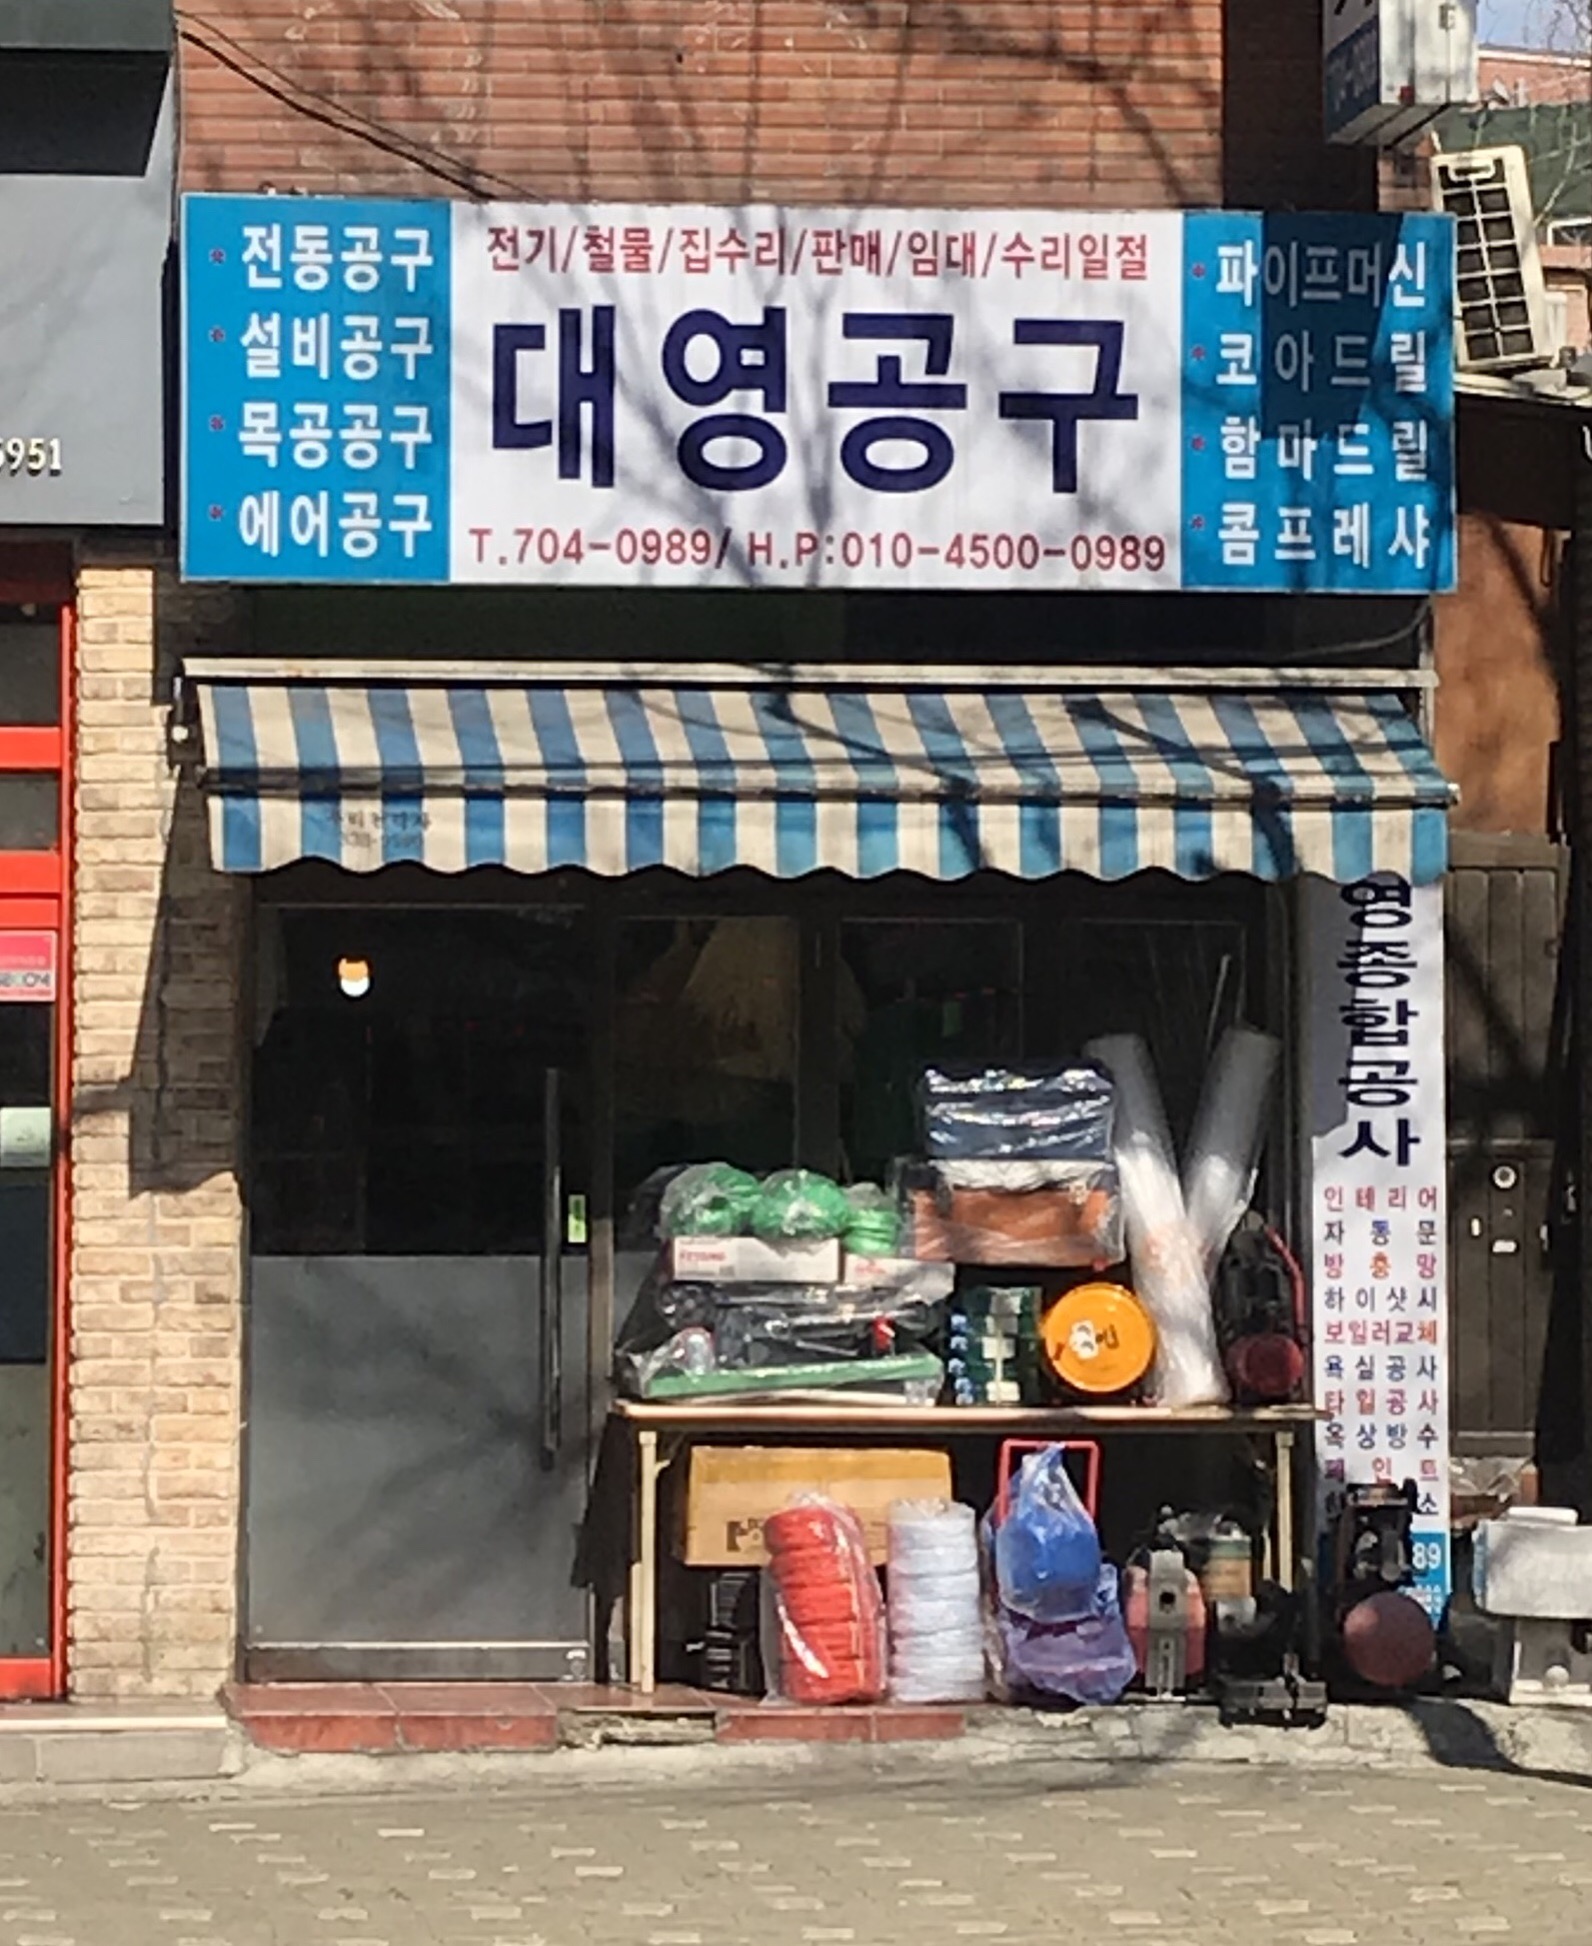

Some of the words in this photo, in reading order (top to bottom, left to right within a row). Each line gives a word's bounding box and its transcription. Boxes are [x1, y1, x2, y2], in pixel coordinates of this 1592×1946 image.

[242, 223, 433, 292] 전동공구
[1216, 242, 1427, 307] 파이프머신
[239, 312, 433, 380] 설비공구
[1216, 332, 1428, 393] 코아드릴
[491, 304, 1140, 494] 대영공구
[238, 402, 432, 469] 목공공구
[1220, 416, 1428, 482] 함마드릴
[239, 490, 432, 558] 에어공구
[1218, 502, 1431, 570] 콤프레샤
[1323, 1185, 1438, 1213] 인테리어
[1323, 1219, 1437, 1246] 자동문
[1323, 1251, 1437, 1280] 방충망
[1324, 1286, 1437, 1312] 하이샷시
[1323, 1319, 1437, 1346] 보일러교체
[1324, 1354, 1437, 1382] 욕실공사
[1324, 1388, 1438, 1415] 타일공사
[1324, 1422, 1439, 1450] 옥상방수
